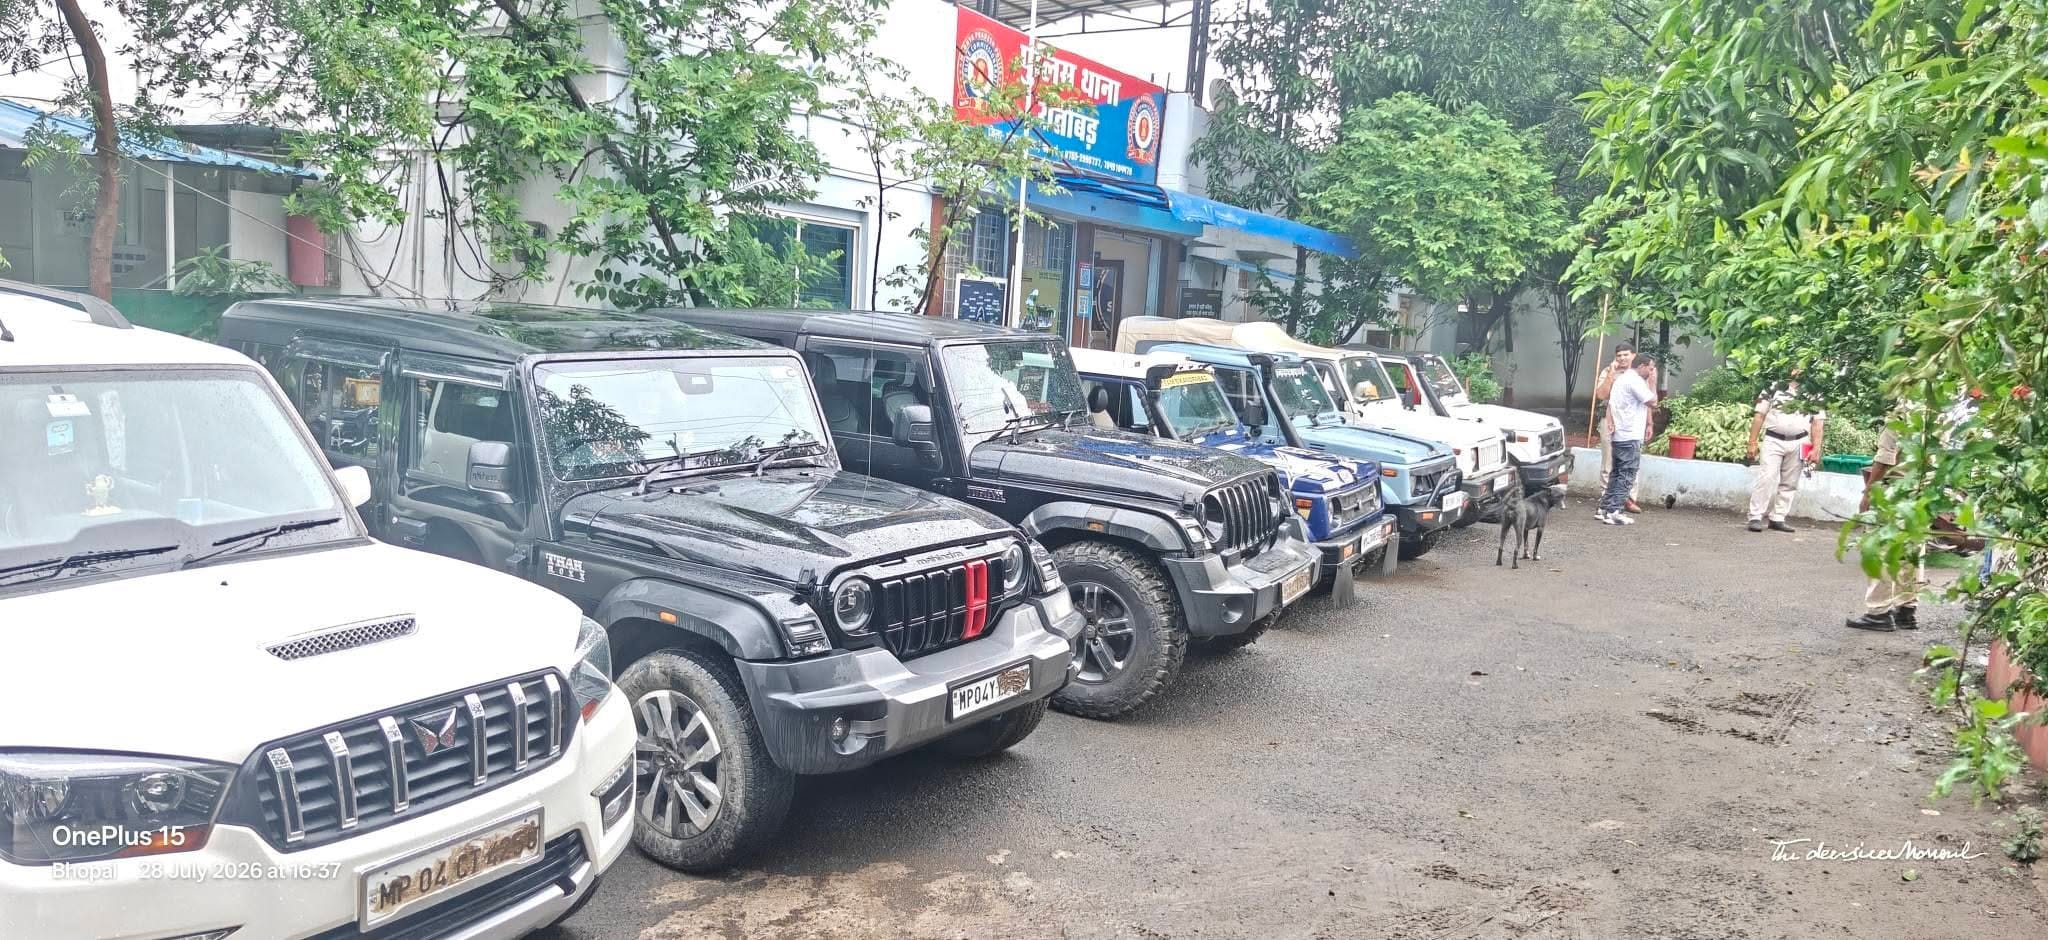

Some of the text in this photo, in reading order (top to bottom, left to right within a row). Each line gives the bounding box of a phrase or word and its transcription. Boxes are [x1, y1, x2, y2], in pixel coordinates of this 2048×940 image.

[1081, 68, 1122, 107] थाना
[545, 552, 583, 571] THAR
[547, 565, 585, 581] ROXX
[379, 874, 412, 910] MP
[419, 859, 448, 893] 04
